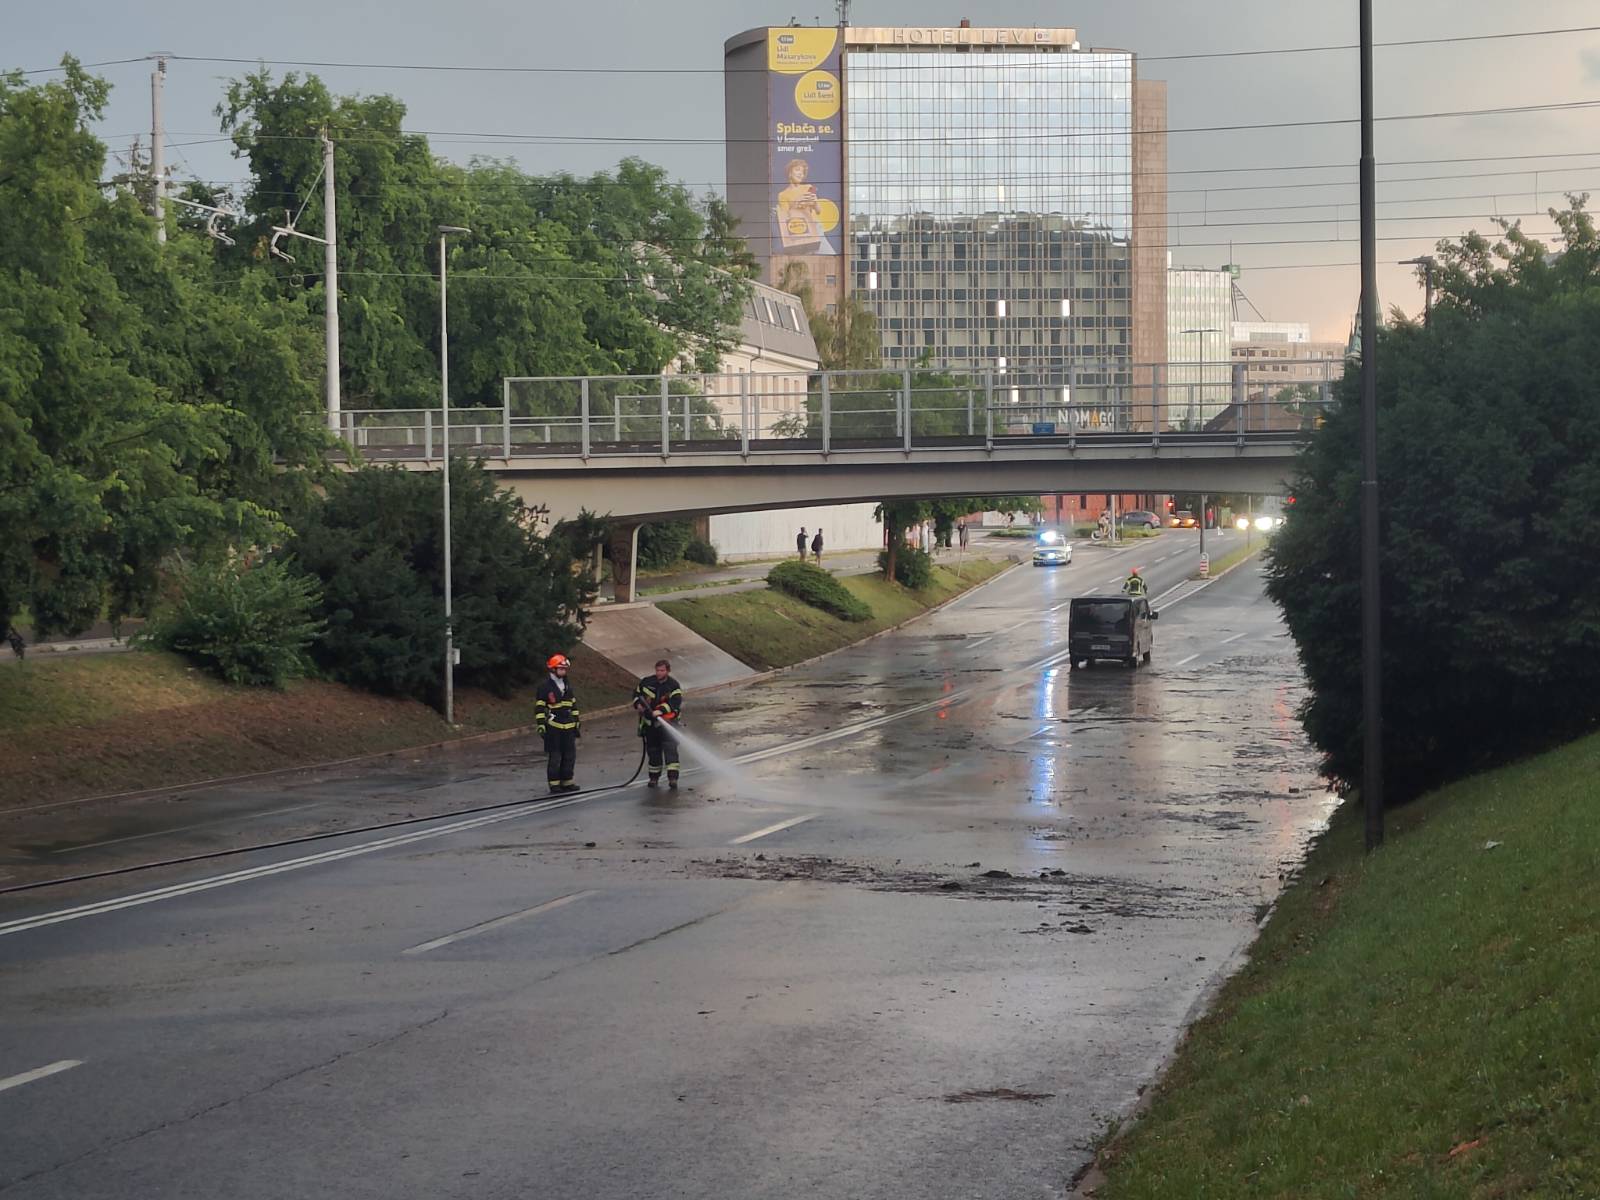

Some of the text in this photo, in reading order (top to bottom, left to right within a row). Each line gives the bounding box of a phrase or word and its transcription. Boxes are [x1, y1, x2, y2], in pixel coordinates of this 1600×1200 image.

[892, 29, 970, 44] HOTEL
[982, 29, 1025, 44] LEV
[776, 122, 835, 136] Splača se.
